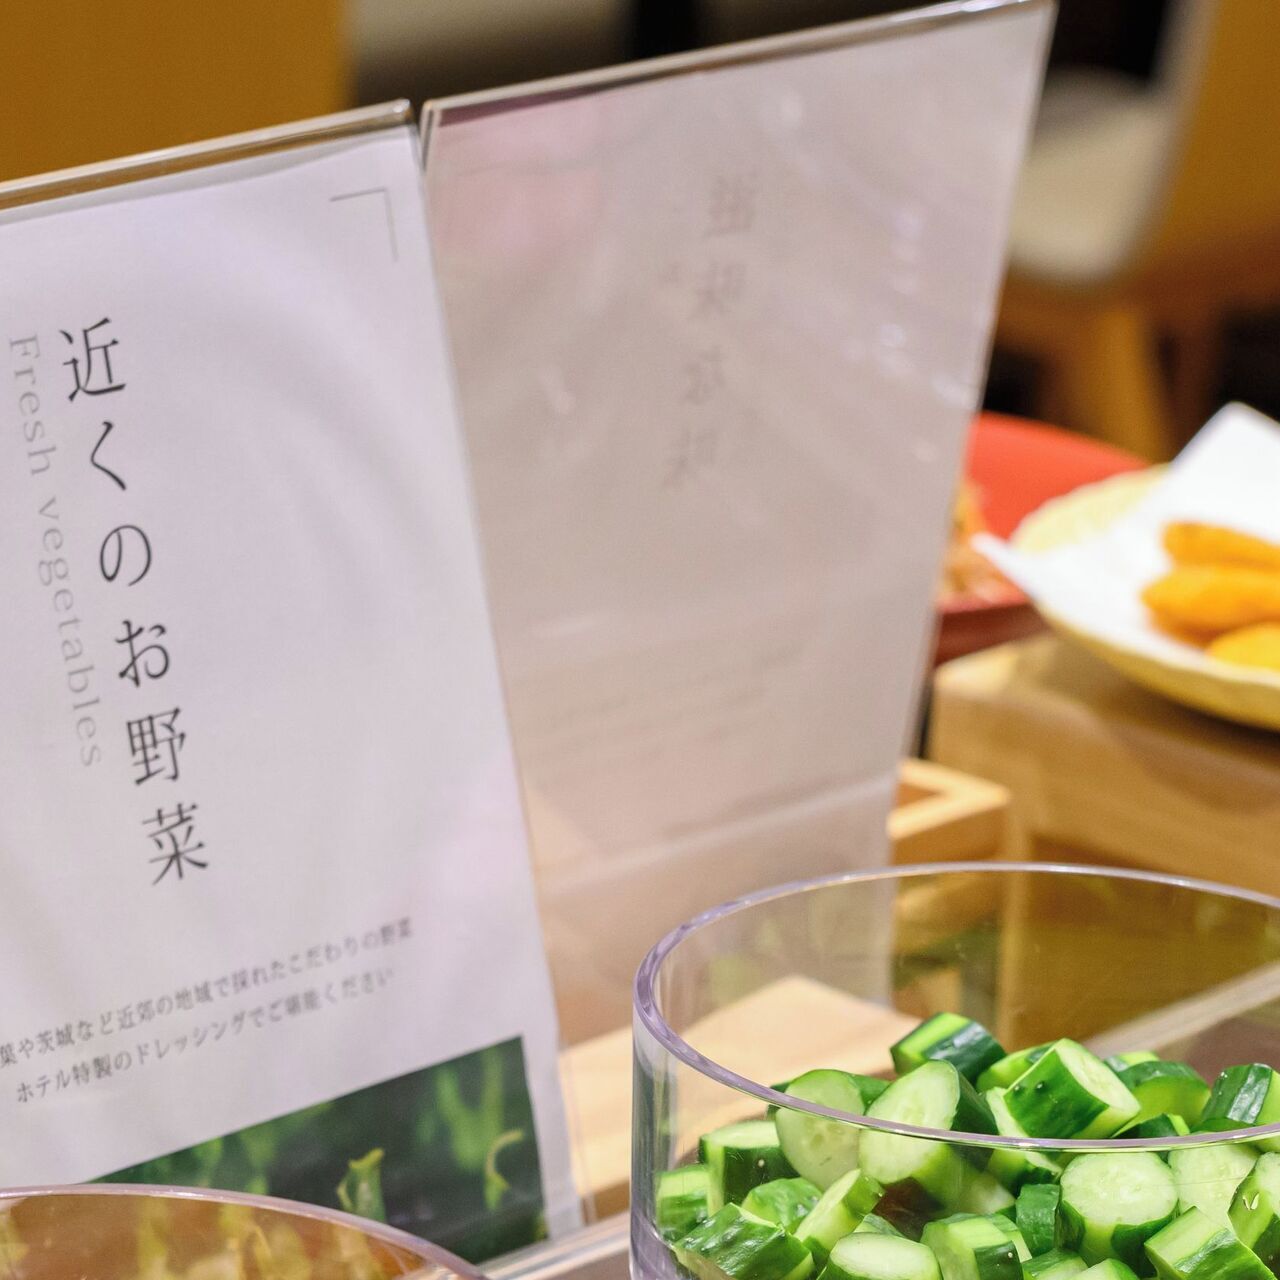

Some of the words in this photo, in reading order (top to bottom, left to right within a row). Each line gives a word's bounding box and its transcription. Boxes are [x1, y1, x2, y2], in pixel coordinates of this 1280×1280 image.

[9, 334, 57, 476] Fresh
[37, 496, 102, 768] vegetables
[58, 317, 208, 885] 近くのお野菜
